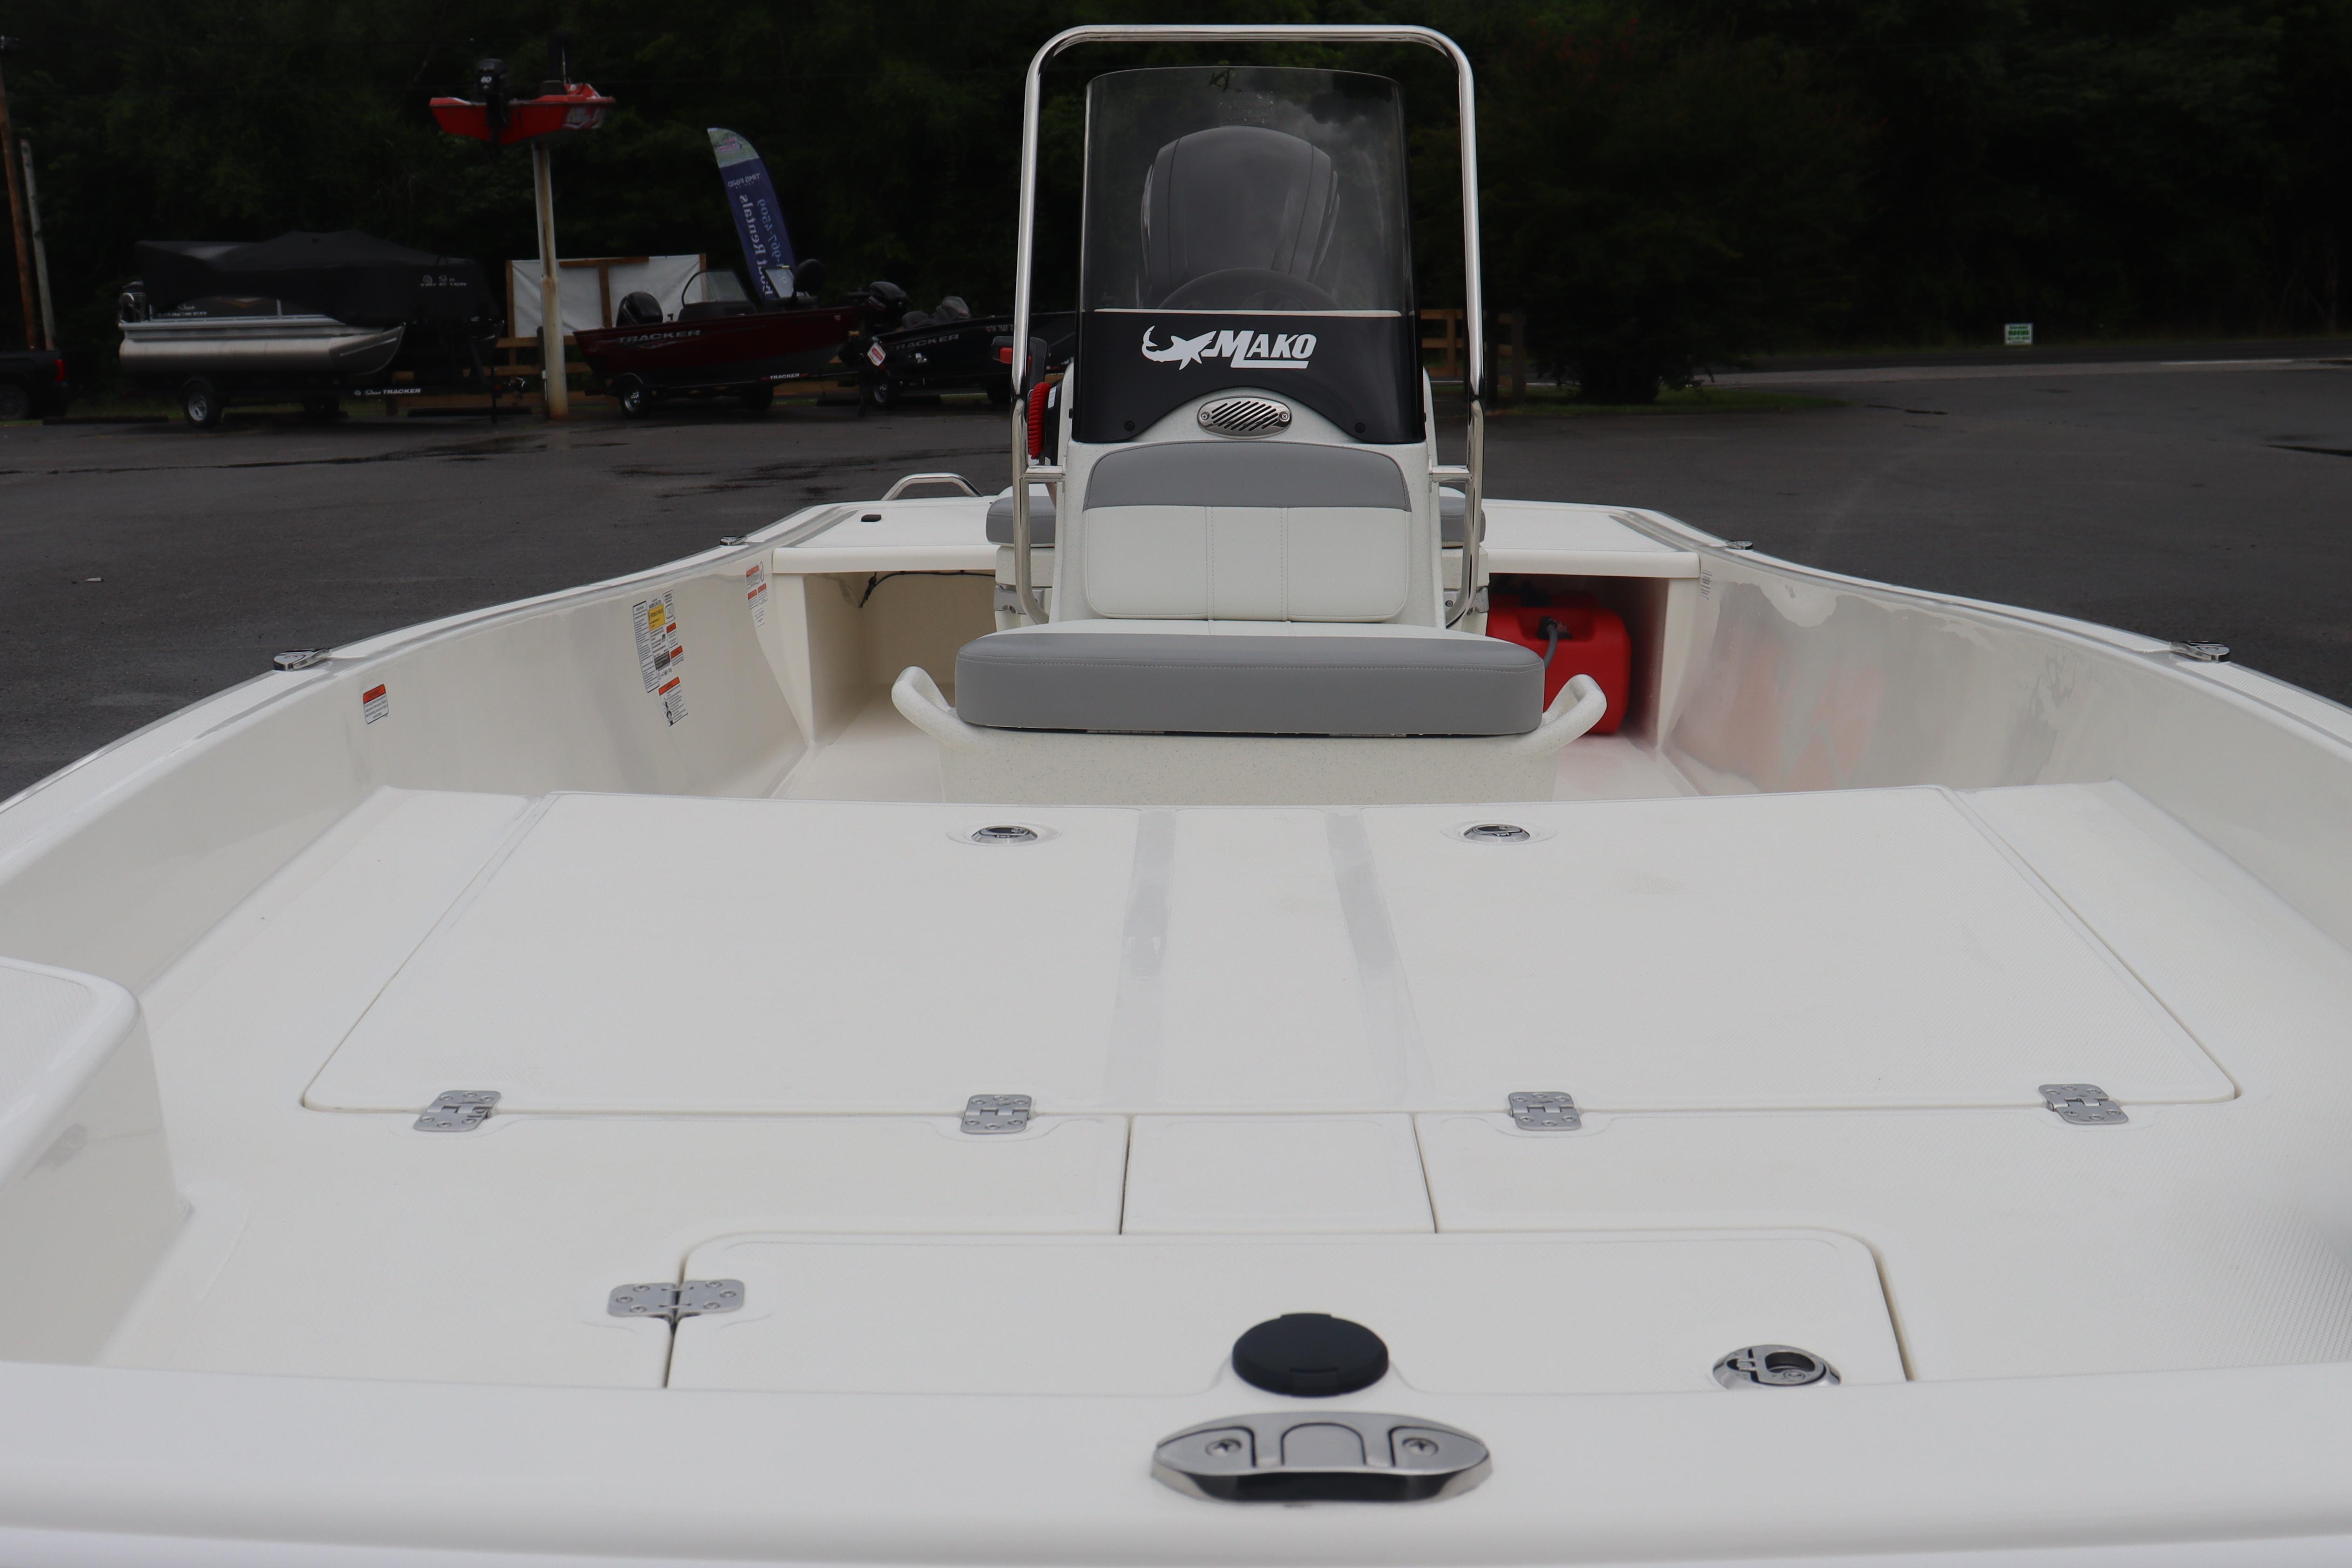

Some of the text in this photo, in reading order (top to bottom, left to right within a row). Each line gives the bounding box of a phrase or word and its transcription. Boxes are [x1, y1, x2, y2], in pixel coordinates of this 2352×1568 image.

[618, 330, 701, 344] TRACKER
[887, 334, 960, 351] TRACKER
[1200, 330, 1317, 369] MAKO
